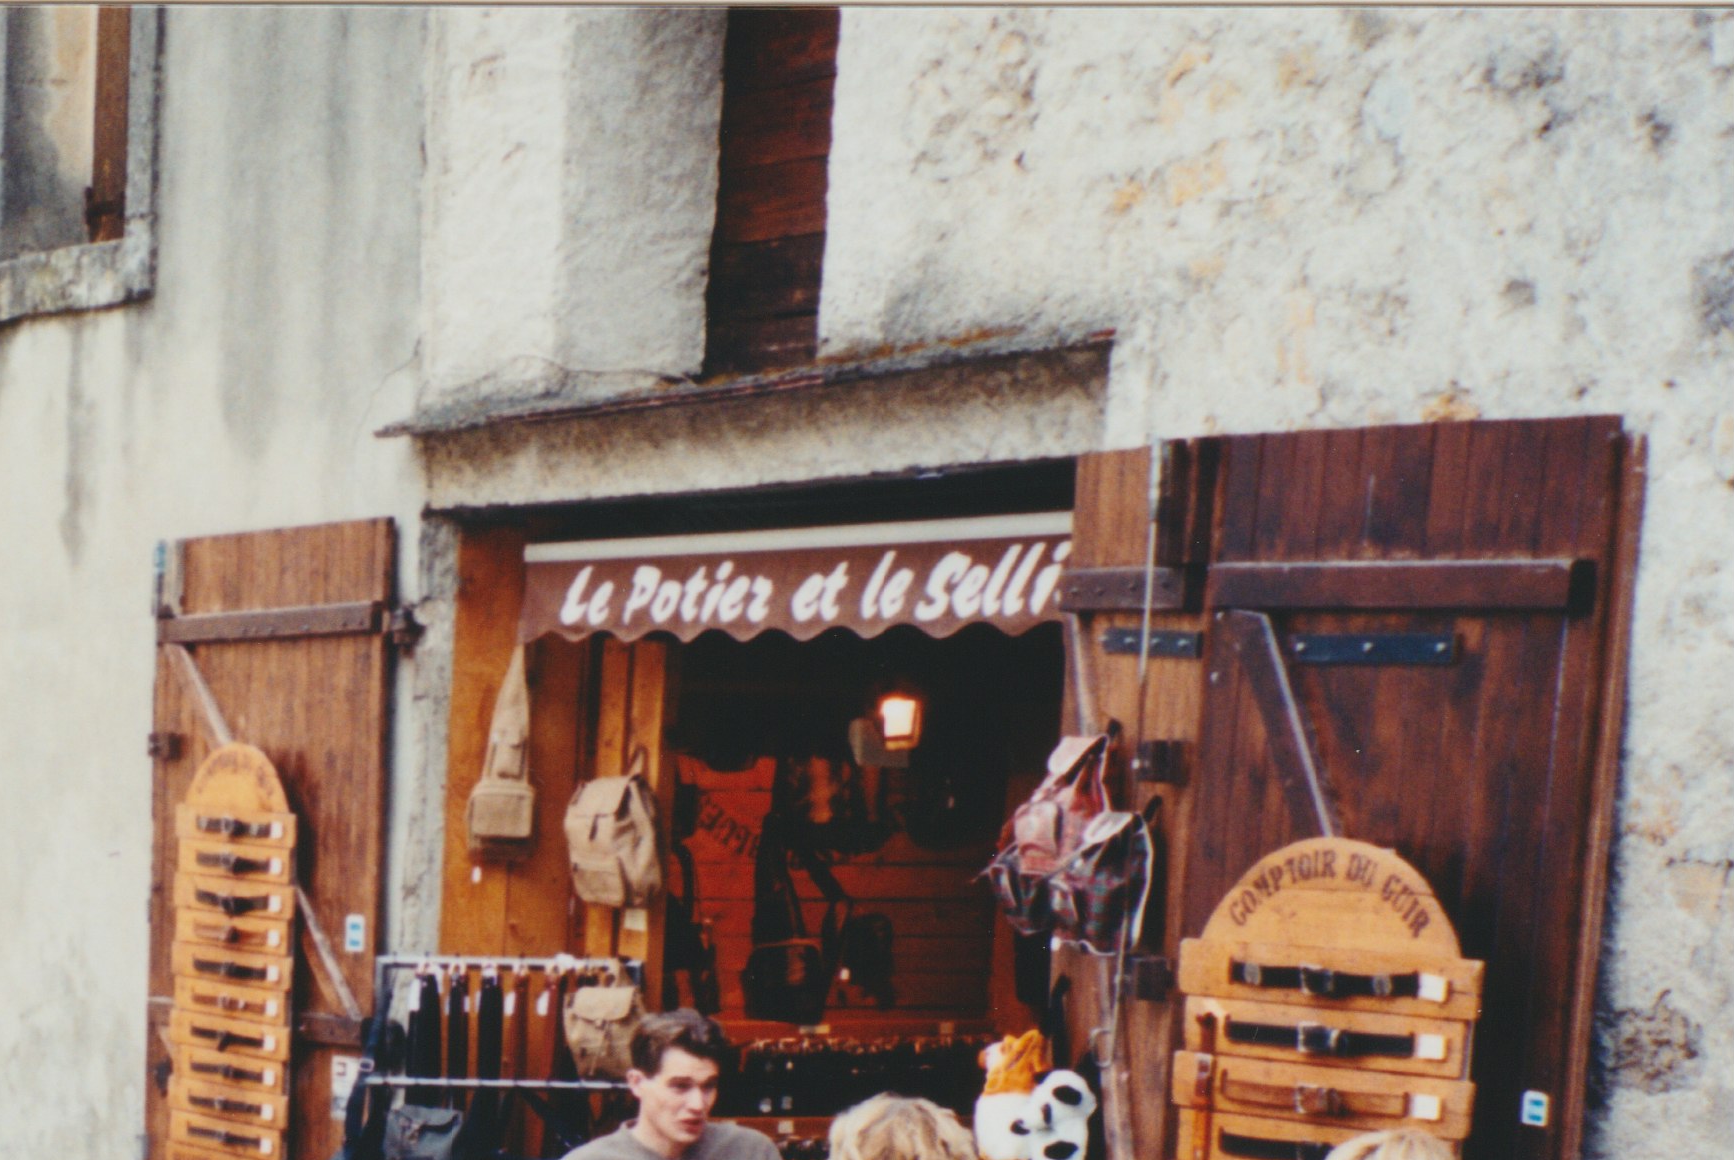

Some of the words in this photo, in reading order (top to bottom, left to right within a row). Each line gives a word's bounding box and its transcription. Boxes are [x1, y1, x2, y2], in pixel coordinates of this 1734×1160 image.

[560, 565, 614, 626] Le
[623, 560, 774, 625] Potier
[791, 561, 850, 623] et
[860, 549, 916, 623] le
[915, 540, 1073, 622] Selli
[1229, 849, 1336, 926] COMPTOIR
[1346, 852, 1379, 889] DU
